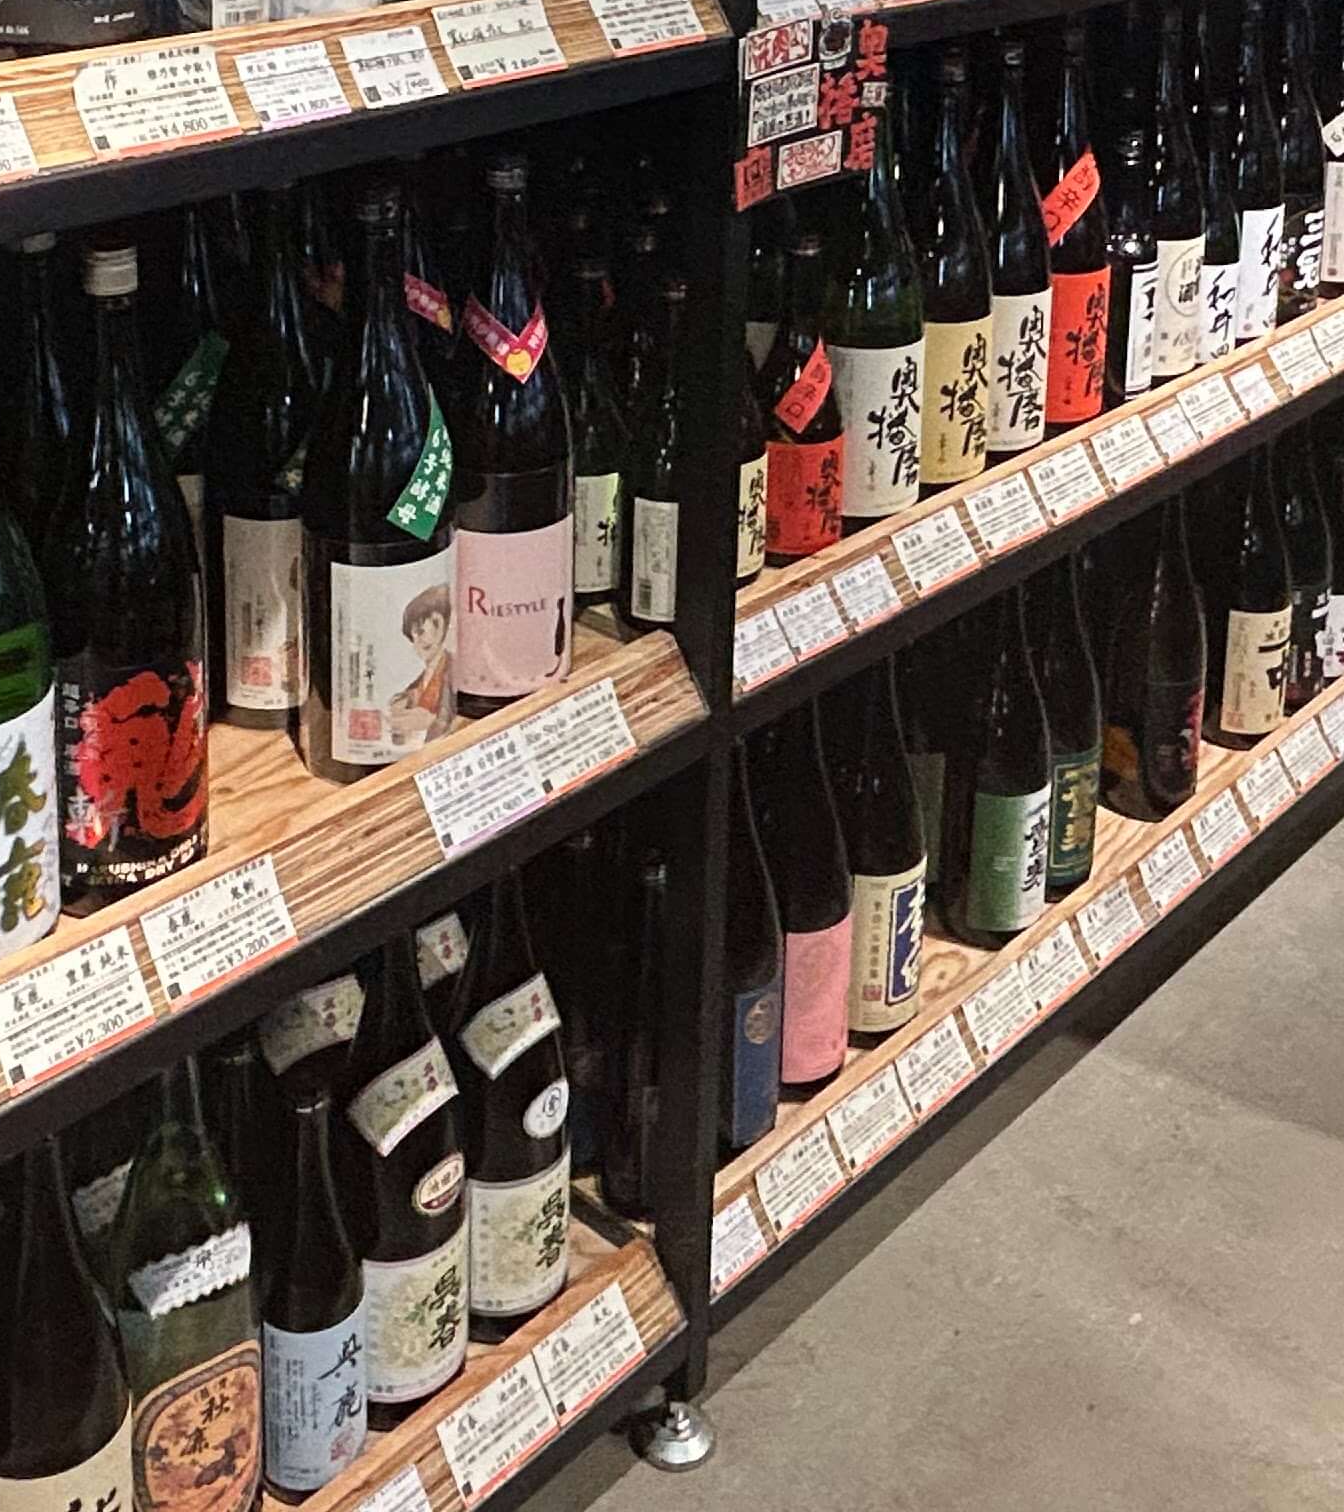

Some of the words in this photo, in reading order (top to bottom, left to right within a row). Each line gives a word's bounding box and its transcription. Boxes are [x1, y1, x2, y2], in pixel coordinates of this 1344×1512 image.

[997, 304, 1047, 432] 奥播磨
[941, 332, 989, 458] 奥播磨
[866, 355, 921, 487] 奥播磨
[98, 944, 131, 972] 純米
[224, 933, 271, 968] ¥3,200
[10, 984, 44, 1013] 春鹿
[74, 1013, 126, 1053] ¥2,300
